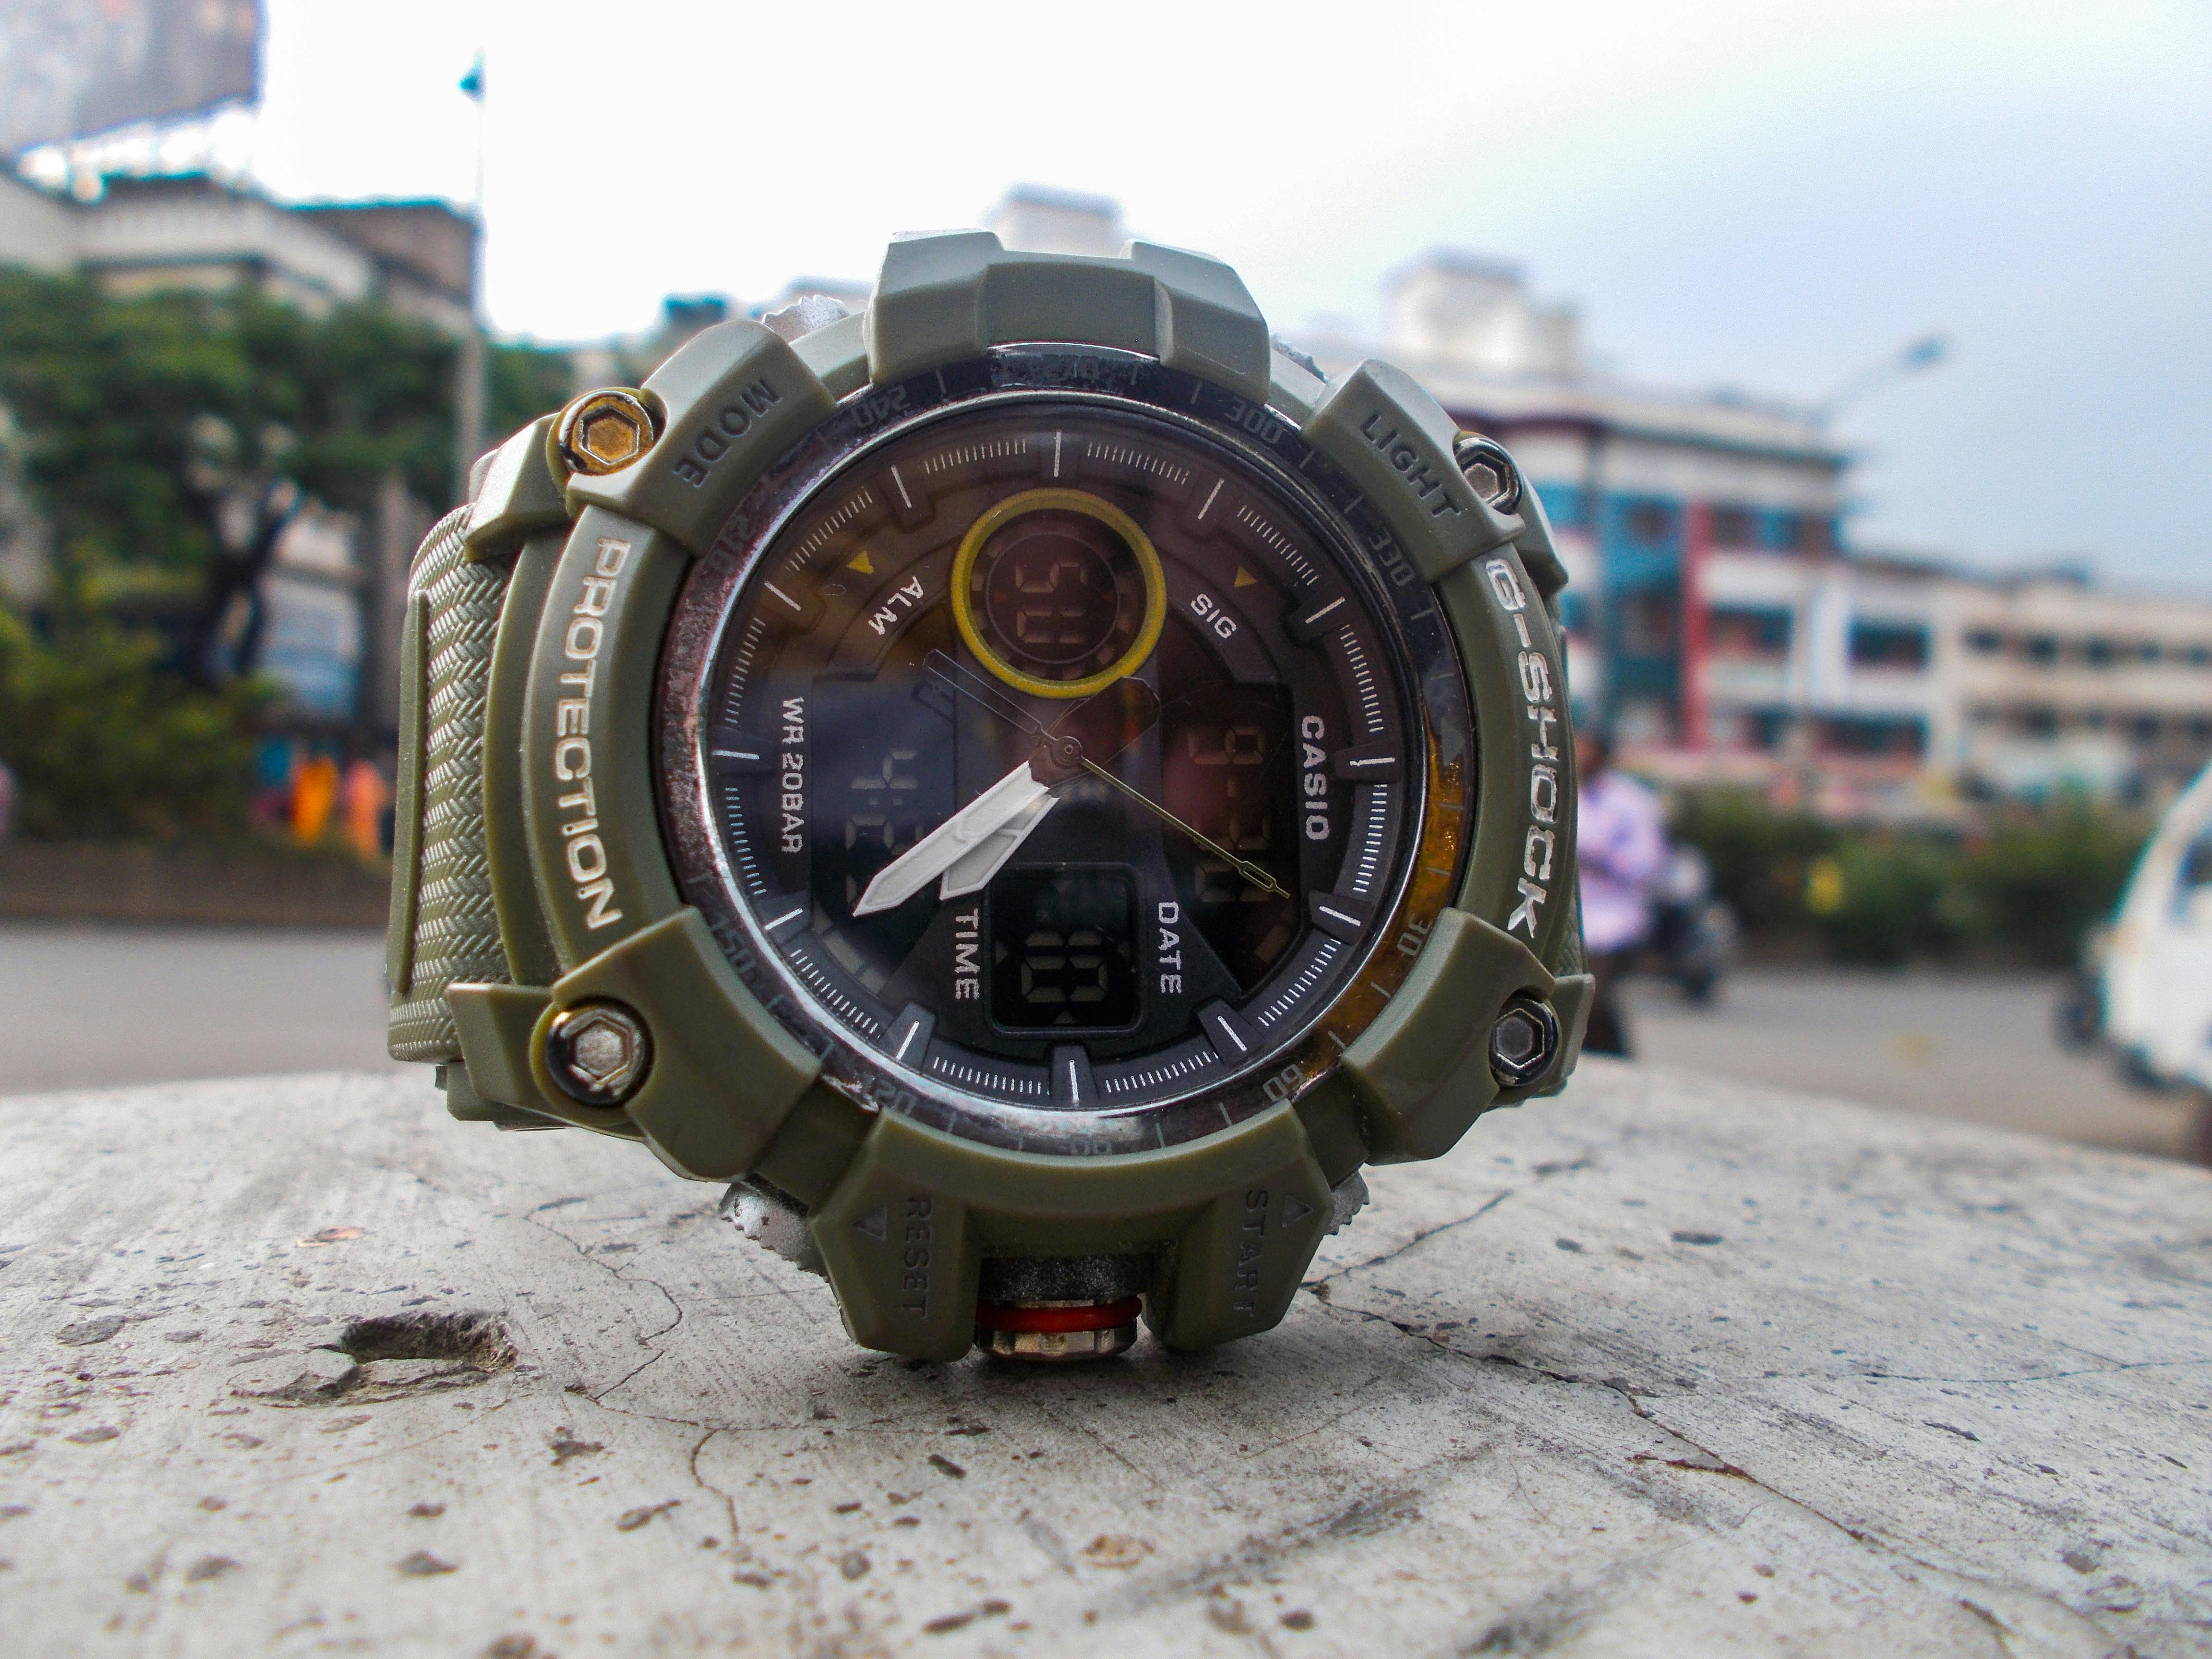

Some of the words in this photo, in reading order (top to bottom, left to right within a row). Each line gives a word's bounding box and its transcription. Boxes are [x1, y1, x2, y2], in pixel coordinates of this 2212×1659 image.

[673, 379, 782, 488] MODE
[851, 385, 910, 429] 240
[1224, 395, 1285, 445] 300
[1360, 413, 1462, 519] LIGHT
[1368, 528, 1415, 587] 330
[868, 576, 925, 636] ALM
[1190, 593, 1237, 639] SIG
[555, 537, 632, 931] PROTECTION
[782, 697, 805, 744] WR
[1486, 558, 1559, 938] G-SHOCK
[781, 753, 805, 854] 20BAR
[1301, 715, 1330, 841] CASIO
[955, 908, 980, 1000] TIME
[1157, 901, 1182, 995] DATE
[1397, 914, 1433, 957] 30
[902, 1196, 933, 1319] RESET
[1233, 1188, 1268, 1317] START
